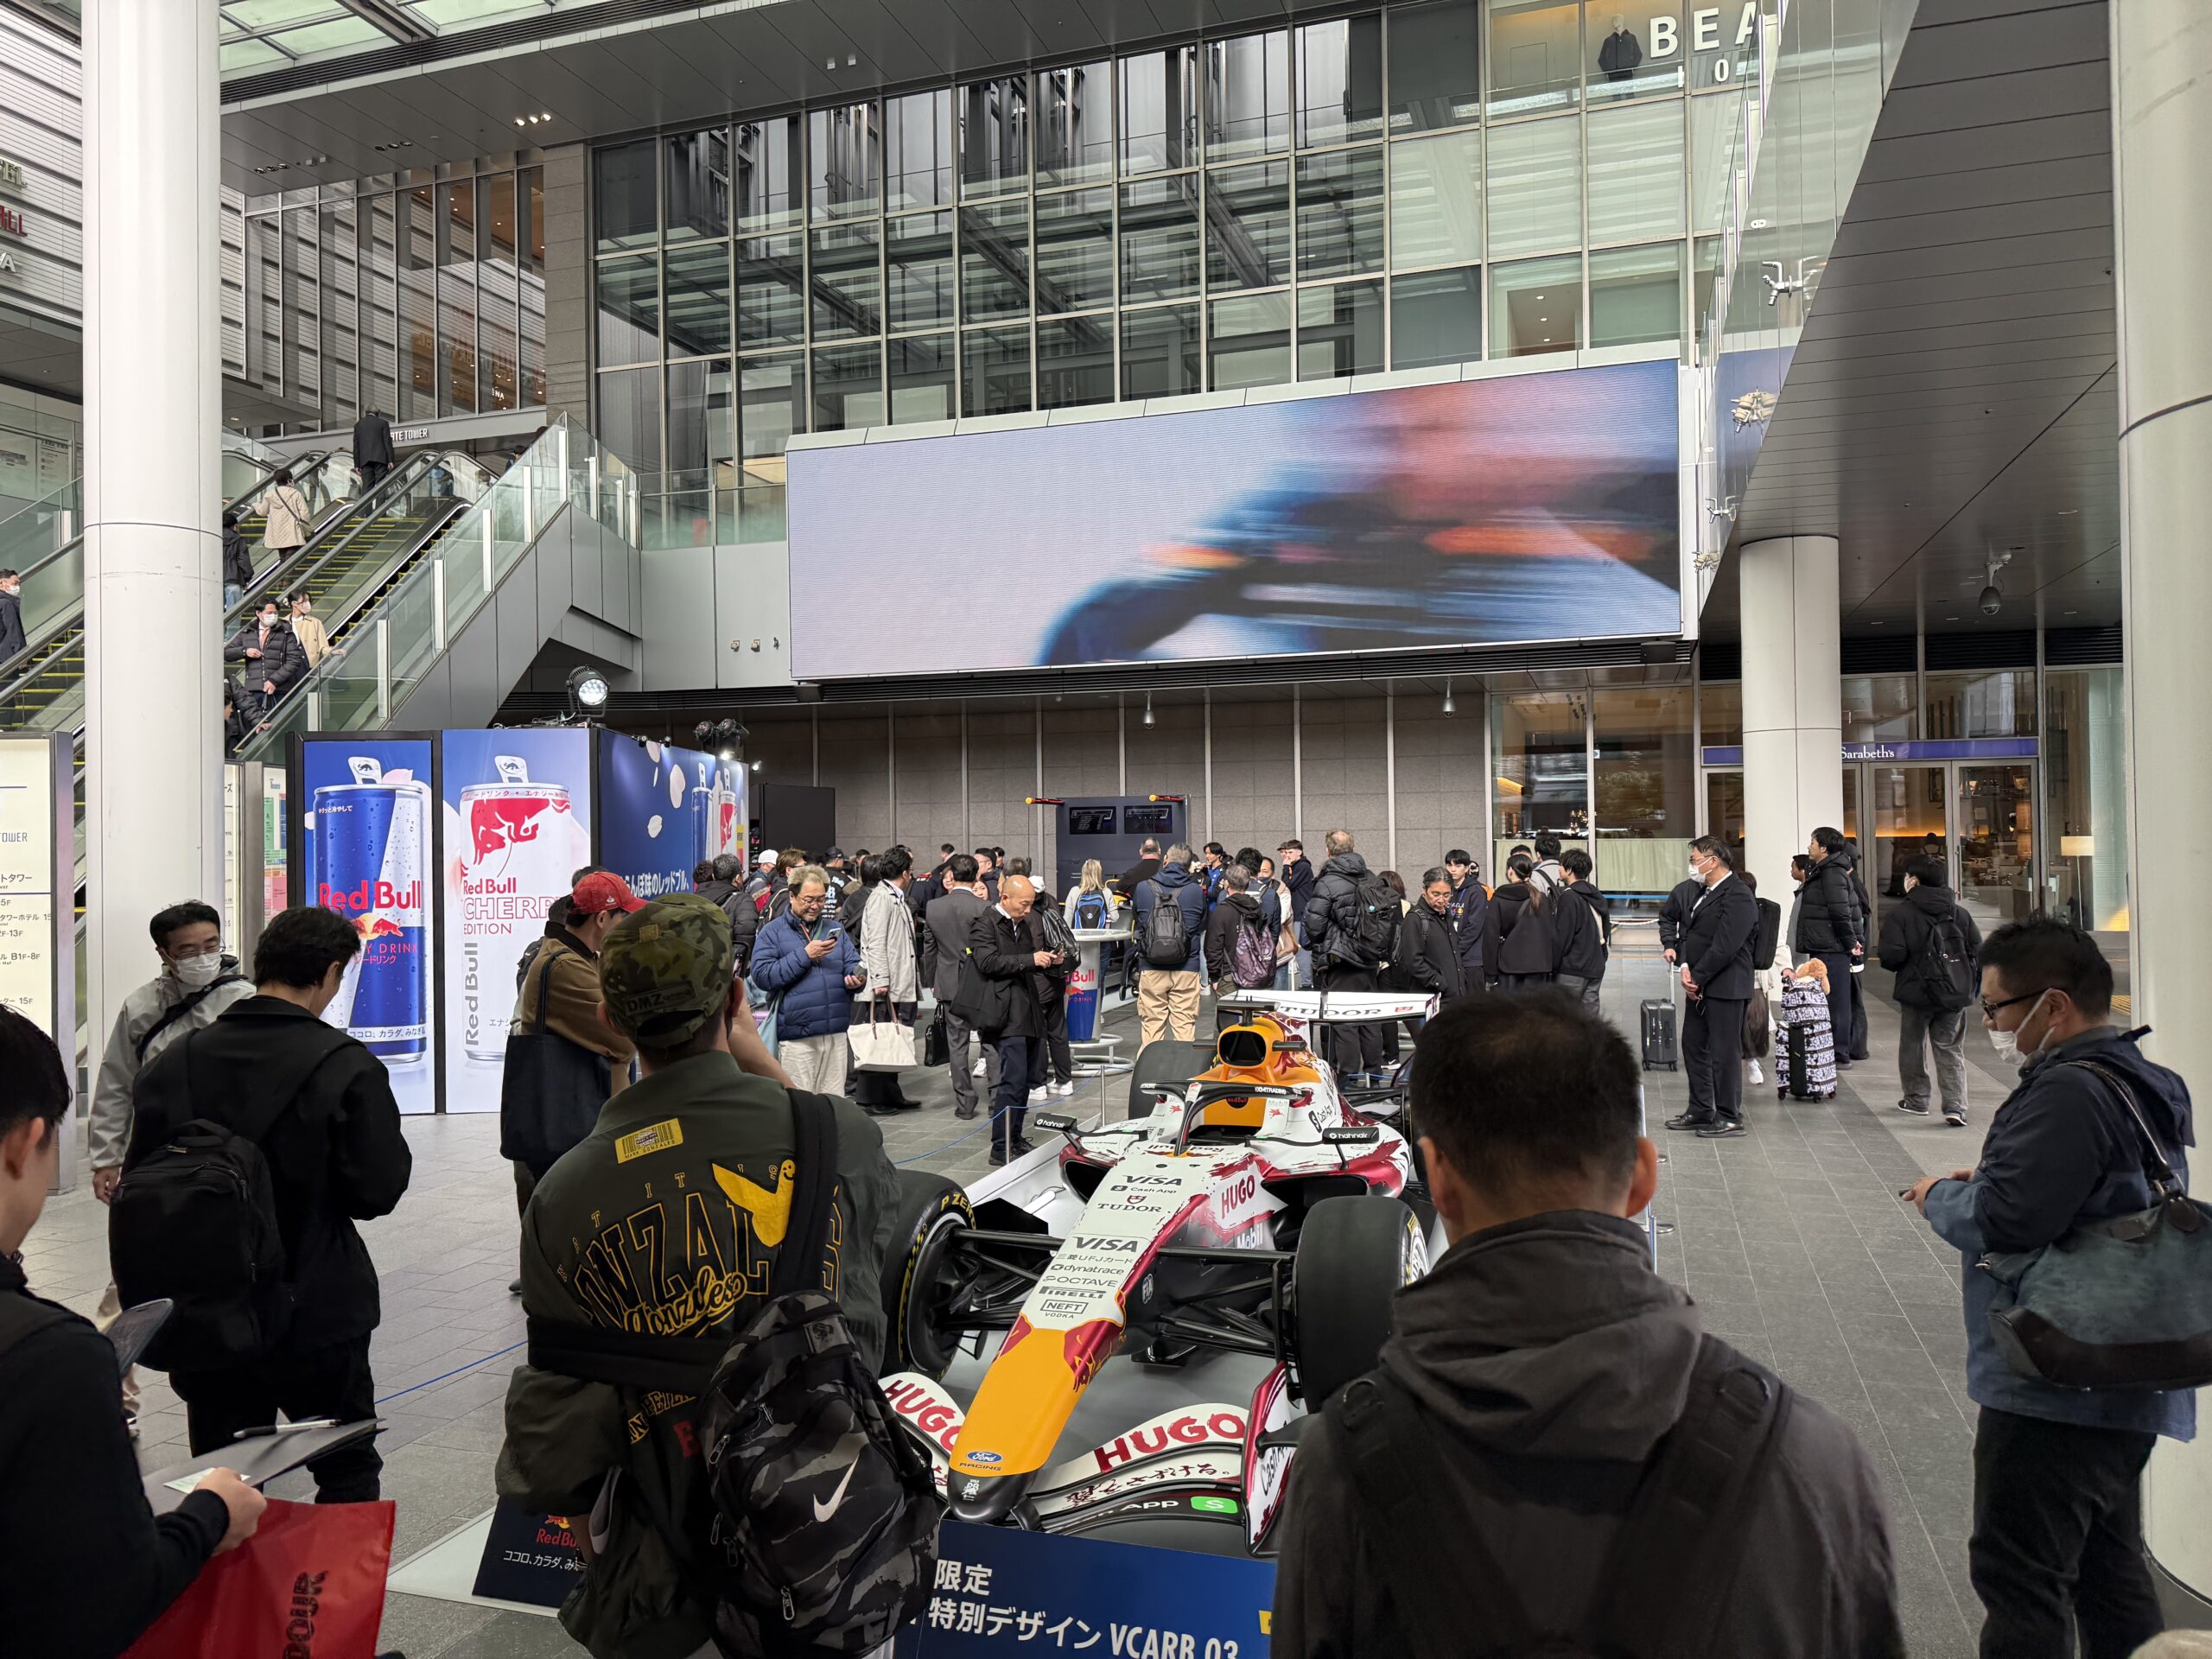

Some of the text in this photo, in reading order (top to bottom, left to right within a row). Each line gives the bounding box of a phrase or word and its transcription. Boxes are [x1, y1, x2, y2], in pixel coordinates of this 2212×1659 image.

[404, 428, 429, 441] TOWER
[1840, 746, 1895, 760] Sarabeth's
[0, 832, 28, 842] OWER
[463, 877, 517, 895] Red Bull
[319, 880, 422, 911] Red Bull
[463, 923, 512, 935] EDITION
[1071, 969, 1095, 982] Bull
[464, 943, 479, 1046] Red Bull
[1278, 1005, 1382, 1018] TUDOR
[1043, 1119, 1065, 1128] hahnair
[1123, 1175, 1182, 1185] VISA
[1221, 1174, 1255, 1220] HUGO
[1097, 1202, 1163, 1212] TUDOR
[1236, 1223, 1263, 1250] Mobil
[1072, 1236, 1139, 1254] VISA
[1057, 1253, 1135, 1263] 三菱UFJカード
[1064, 1265, 1125, 1275] dynatrace
[1057, 1276, 1119, 1287] OCTAVE
[1038, 1286, 1108, 1300] PIRELLI
[1046, 1301, 1084, 1312] NEFT
[1093, 1412, 1246, 1474] HUGO
[971, 1452, 998, 1462] Ford
[958, 1461, 1002, 1471] RACING
[535, 1528, 563, 1546] Red
[932, 1558, 993, 1597] 限定
[928, 1596, 1103, 1650] 特別デザイン
[1109, 1622, 1196, 1659] VCARB
